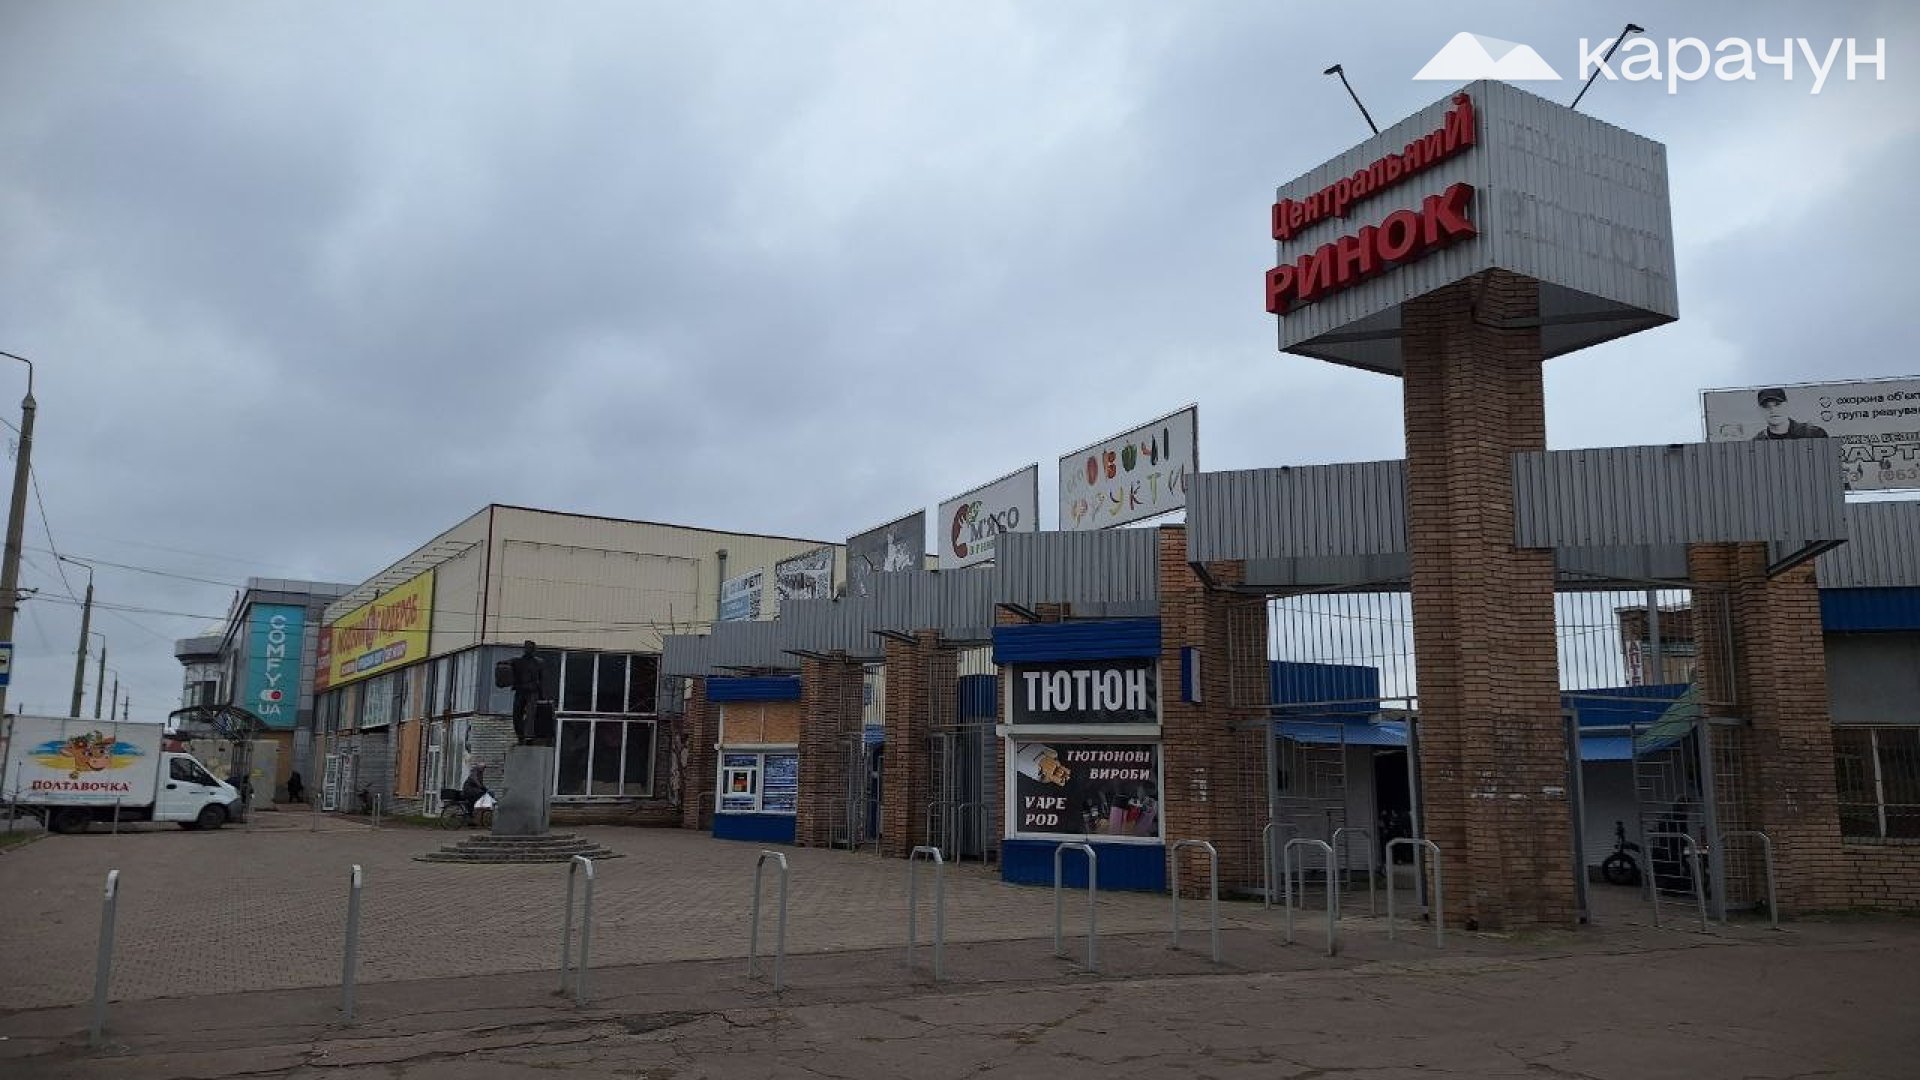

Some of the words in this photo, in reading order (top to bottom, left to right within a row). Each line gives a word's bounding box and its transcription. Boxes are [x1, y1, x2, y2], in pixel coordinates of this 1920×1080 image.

[1266, 182, 1478, 314] РИНОК
[1836, 395, 1885, 406] охорона
[1837, 409, 1870, 421] група
[266, 614, 287, 687] COMFY
[1022, 669, 1147, 711] ТЮТЮН
[257, 703, 281, 715] UA
[1067, 750, 1150, 763] ТЮТЮНОВІ
[1089, 768, 1150, 780] ВИРОБИ
[32, 779, 130, 792] ПОЛТАВОЧКА
[1024, 796, 1067, 810] VAPE
[1025, 813, 1059, 826] POD
